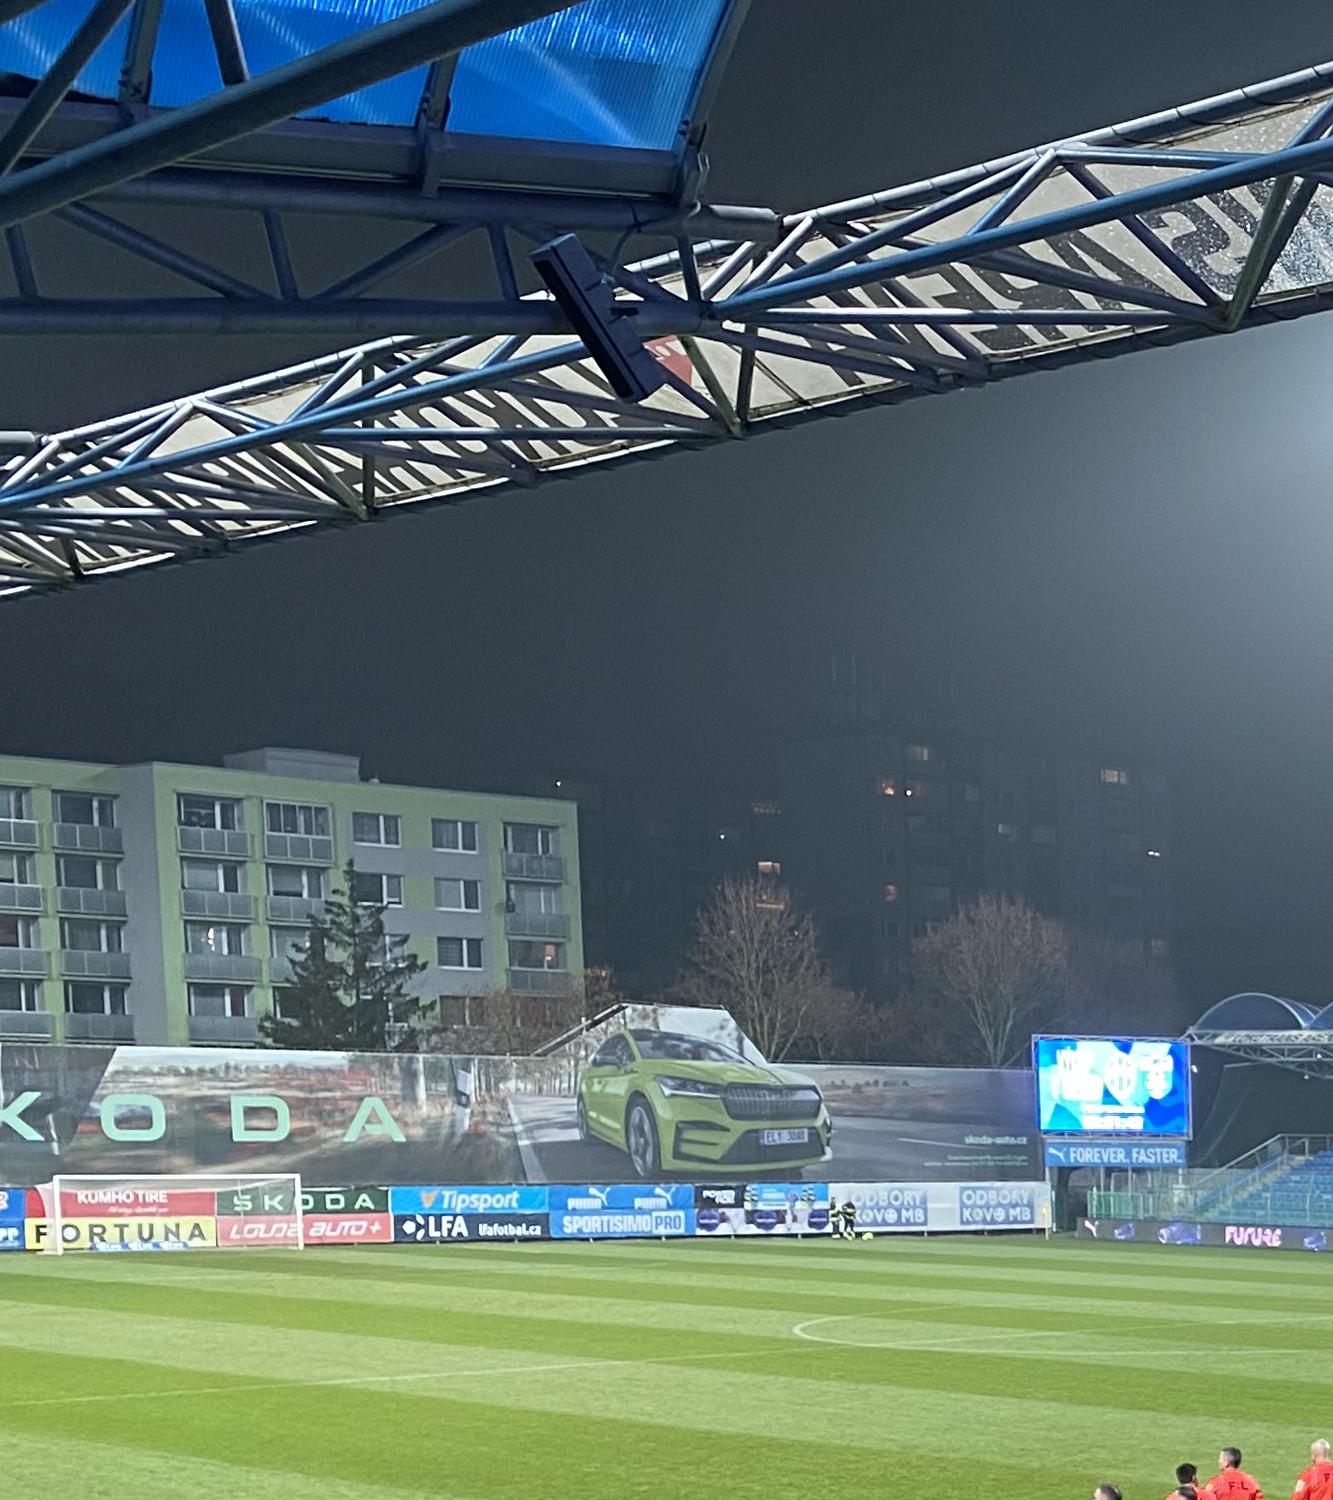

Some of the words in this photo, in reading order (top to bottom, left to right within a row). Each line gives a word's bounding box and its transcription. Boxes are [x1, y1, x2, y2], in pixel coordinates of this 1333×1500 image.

[1069, 1147, 1129, 1164] FOREVER.
[1132, 1147, 1183, 1164] FASTER.
[77, 1190, 136, 1204] KUMHO
[138, 1190, 168, 1204] TIRE
[440, 1190, 520, 1212] Tipsport
[962, 1188, 1030, 1206] ODBORY
[563, 1214, 651, 1234] SPORTISIMO
[653, 1212, 682, 1231] PRO
[902, 1207, 925, 1223] MB
[1009, 1206, 1031, 1222] MB
[35, 1222, 206, 1243] FORTUNA
[428, 1215, 469, 1238] LFA
